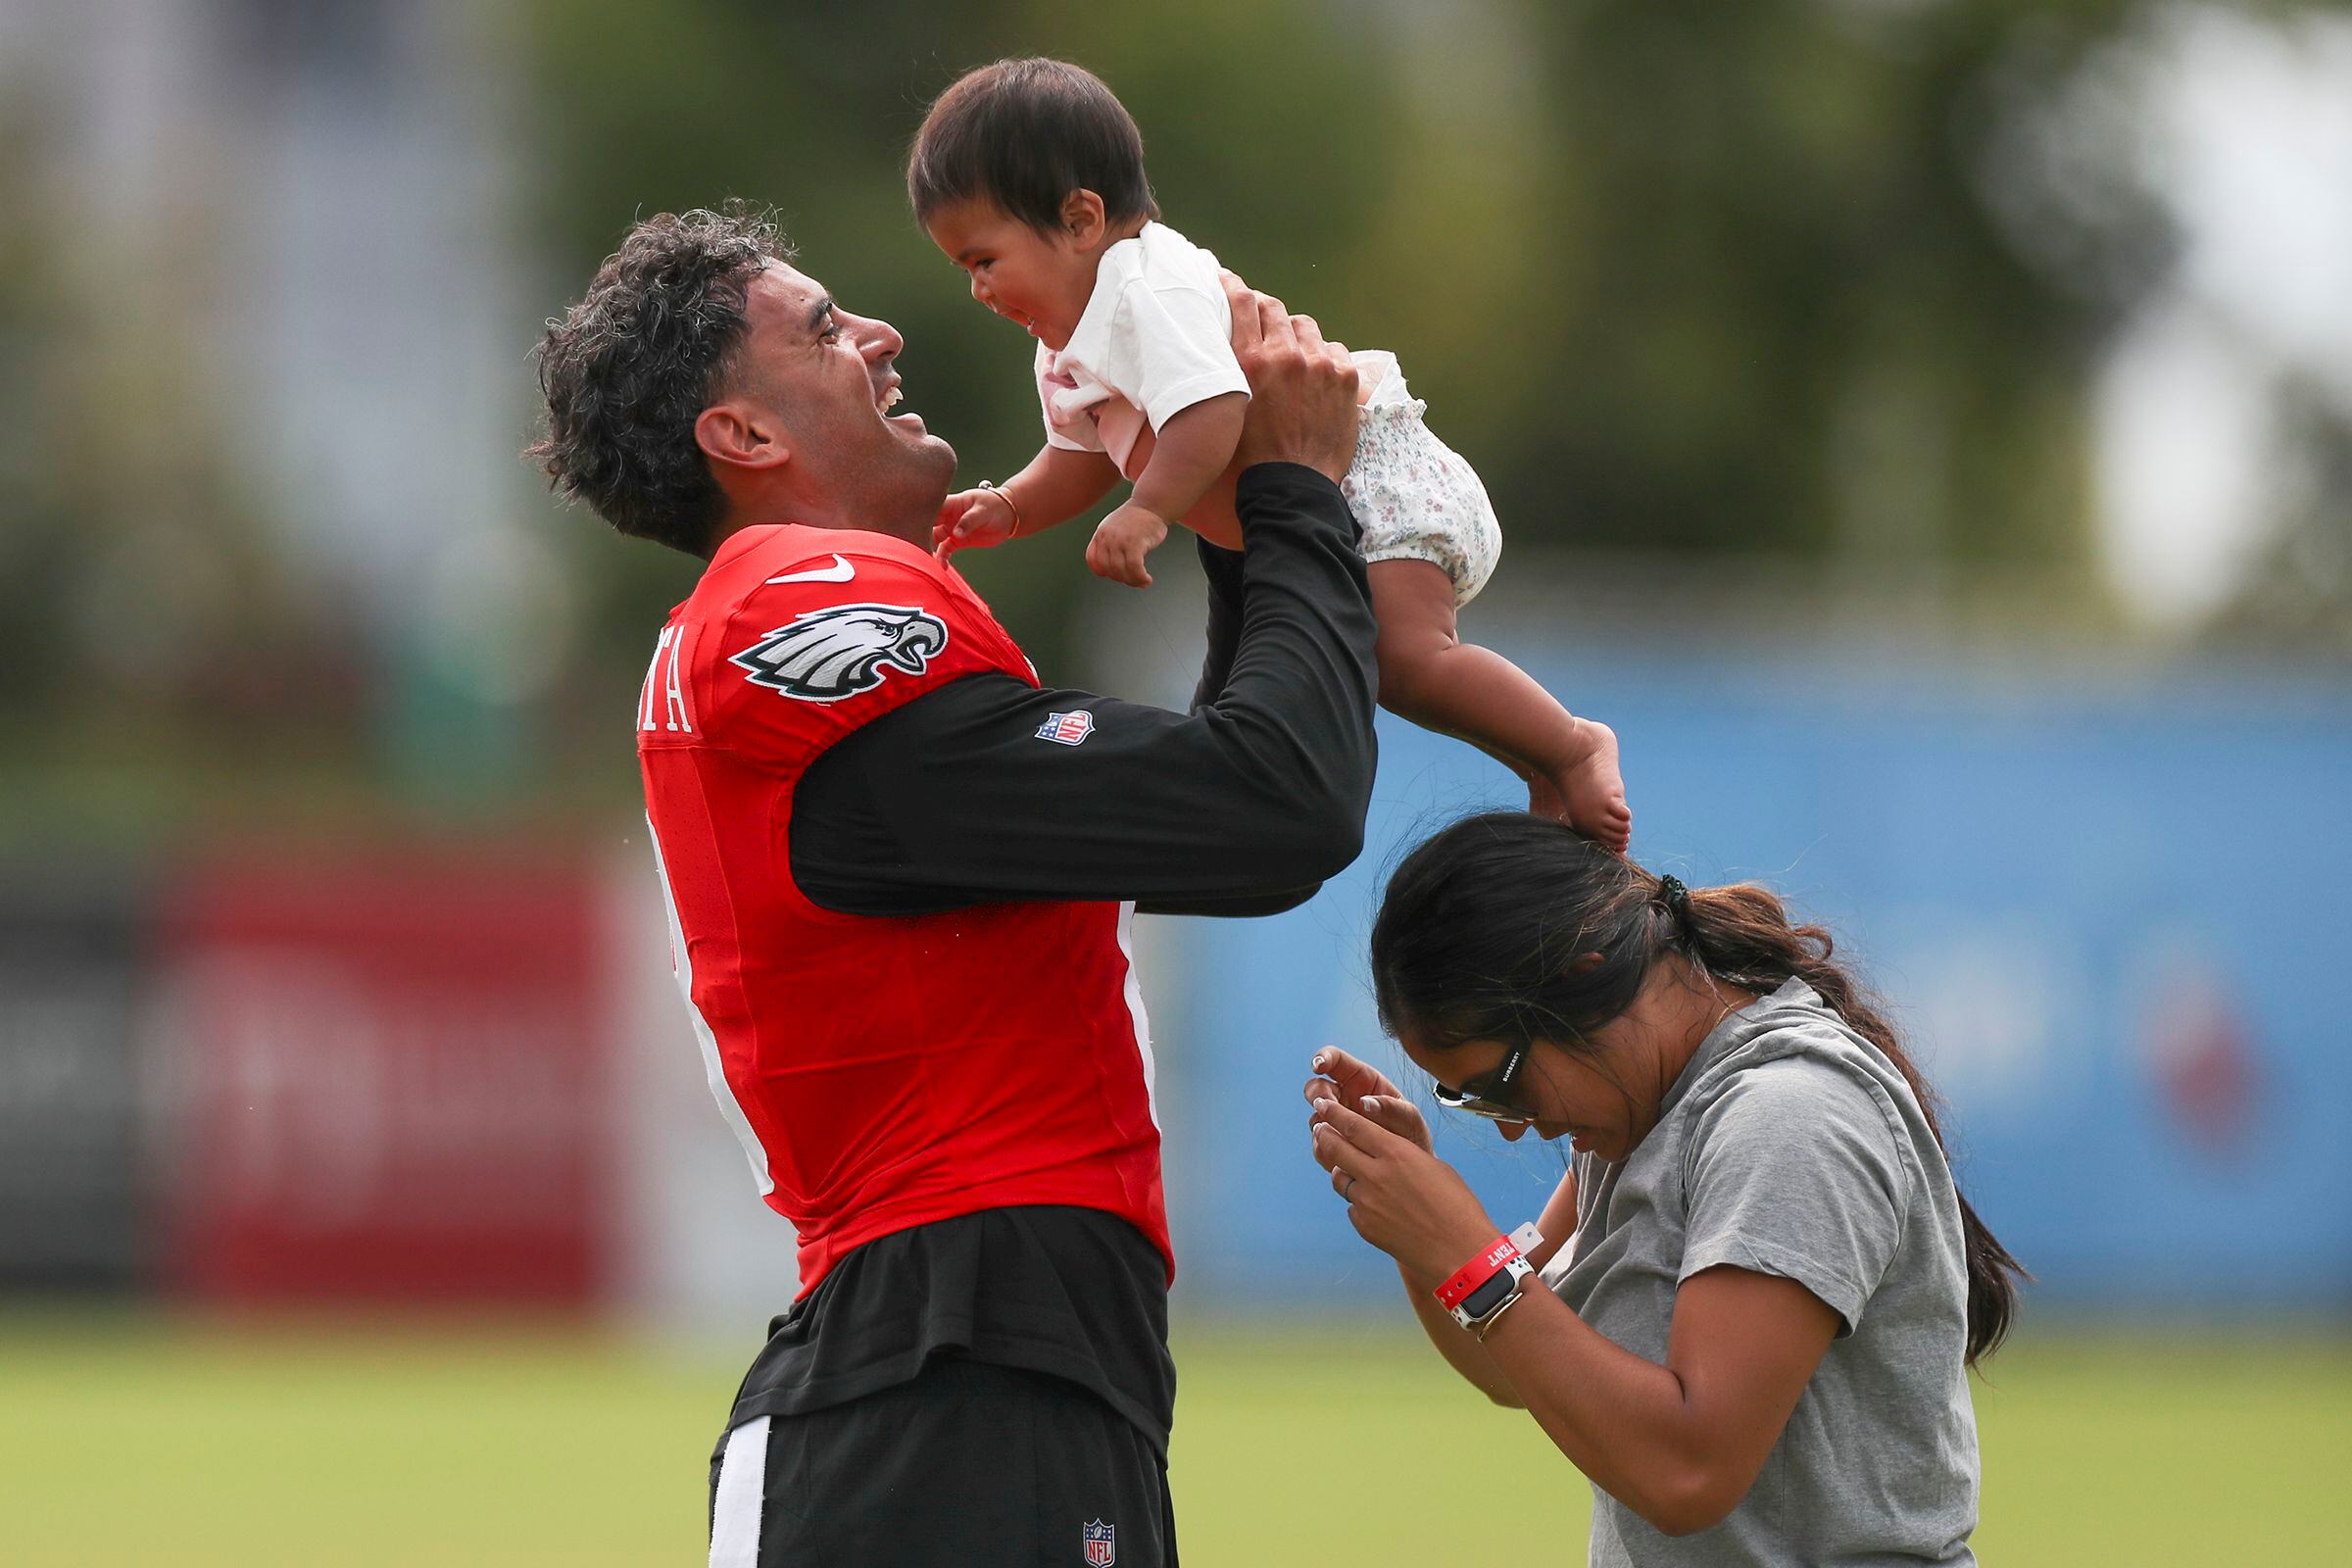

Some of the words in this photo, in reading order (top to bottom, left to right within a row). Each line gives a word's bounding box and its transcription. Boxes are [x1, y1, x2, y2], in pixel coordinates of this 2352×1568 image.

[636, 625, 692, 733] TA
[1057, 713, 1087, 741] NFL
[1502, 1052, 1520, 1082] BURBERRY
[1488, 1242, 1516, 1267] TENT
[1088, 1541, 1111, 1564] NFL
